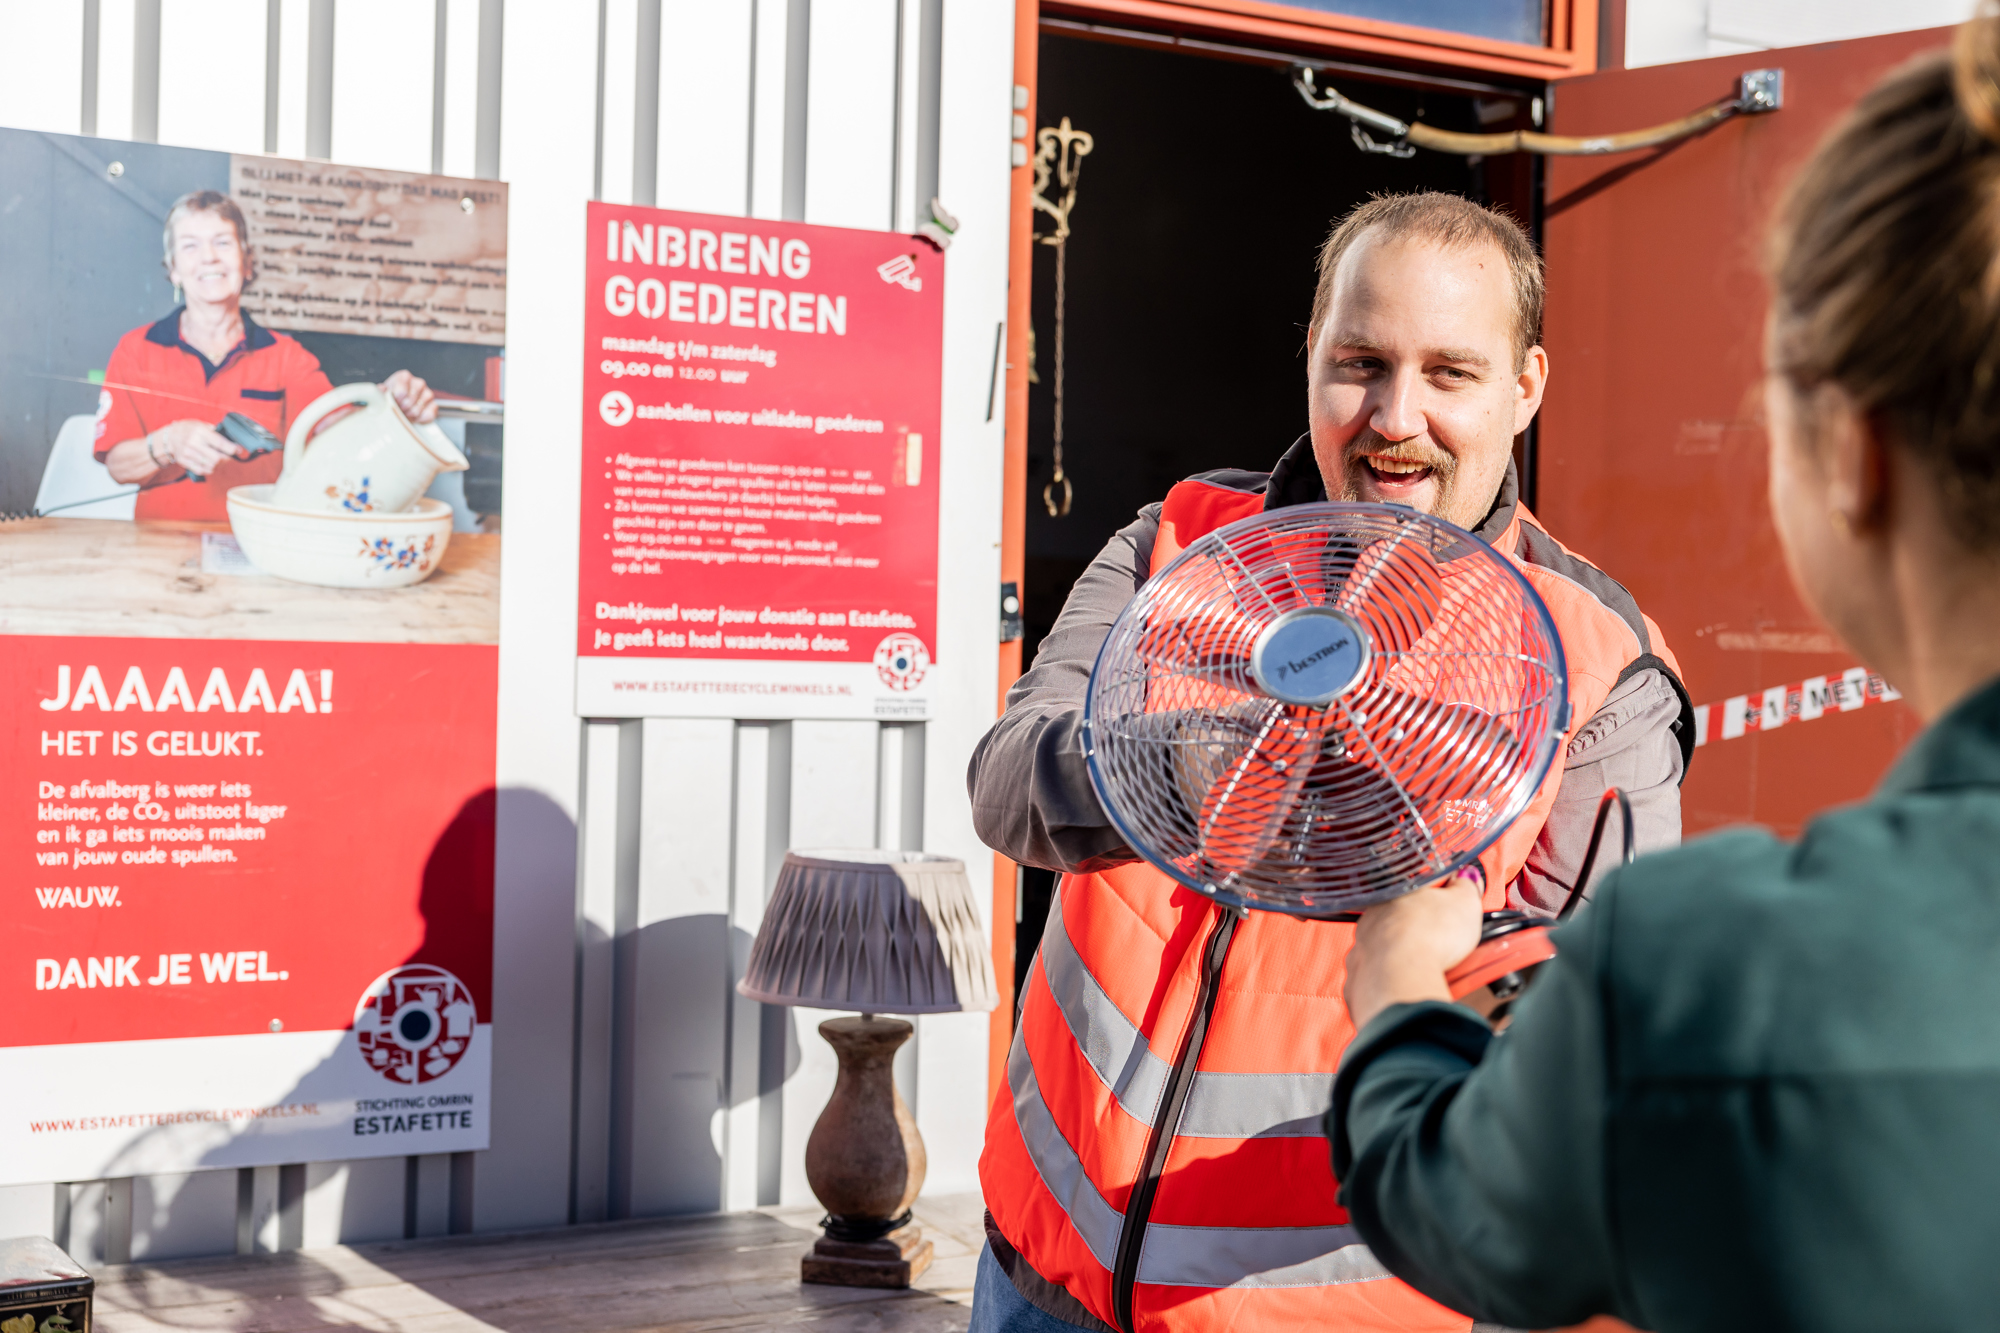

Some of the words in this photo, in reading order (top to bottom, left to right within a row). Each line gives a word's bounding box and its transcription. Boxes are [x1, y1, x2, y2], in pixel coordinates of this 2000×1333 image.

[606, 220, 812, 280] INBRENG
[604, 274, 847, 336] GOEDEREN
[601, 335, 676, 361] maandag
[677, 340, 709, 361] t/m
[711, 344, 777, 368] zaterdag
[600, 359, 651, 378] 09.00
[653, 361, 673, 378] en
[678, 366, 717, 382] 12.00
[720, 369, 749, 384] uur
[636, 402, 712, 424] aanbellen
[713, 407, 750, 425] voor
[751, 410, 813, 430] uitladen
[814, 414, 884, 434] goederen
[633, 470, 665, 483] willen
[659, 457, 679, 469] van
[679, 457, 727, 473] goederen
[631, 499, 671, 514] kunnen
[661, 487, 728, 502] medewerkers
[596, 601, 679, 625] Dankjewel
[680, 606, 717, 624] voor
[717, 604, 757, 627] jouw
[759, 605, 816, 628] donatie
[818, 610, 847, 628] aan
[848, 608, 917, 630] Estafette.
[594, 628, 612, 650] Je
[613, 628, 655, 651] geeft
[656, 630, 687, 650] iets
[688, 629, 723, 650] heel
[724, 631, 810, 652] waardevols
[811, 632, 850, 653] door.
[40, 665, 333, 713] JAAAAAA!
[1810, 673, 1895, 709] METE
[41, 730, 103, 757] HET
[112, 731, 138, 757] IS
[147, 730, 264, 757] GELUKT.
[38, 780, 65, 800] De
[70, 779, 151, 803] afvalberg
[155, 780, 171, 799] is
[174, 783, 217, 800] weer
[220, 779, 251, 799] iets
[38, 802, 102, 824] kleiner,
[106, 802, 129, 821] de
[175, 800, 241, 821] uitstoot
[245, 801, 288, 824] lager
[37, 828, 60, 844] en
[65, 824, 81, 843] ik
[86, 827, 108, 848] ga
[113, 824, 145, 843] iets
[150, 824, 204, 842] moois
[209, 822, 266, 842] maken
[36, 849, 69, 867] van
[73, 847, 117, 870] jouw
[121, 845, 167, 866] oude
[171, 844, 238, 868] spullen.
[36, 885, 122, 909] WAUW.
[35, 954, 140, 991] DANK
[148, 953, 192, 987] JE
[200, 950, 289, 984] WEL.
[354, 1096, 425, 1113] STICHTING
[427, 1093, 474, 1109] OMRIN
[30, 1102, 321, 1134] WWW.ESTAFETTERECYCLEWINKELS.NL
[353, 1109, 472, 1136] ESTAFETTE
